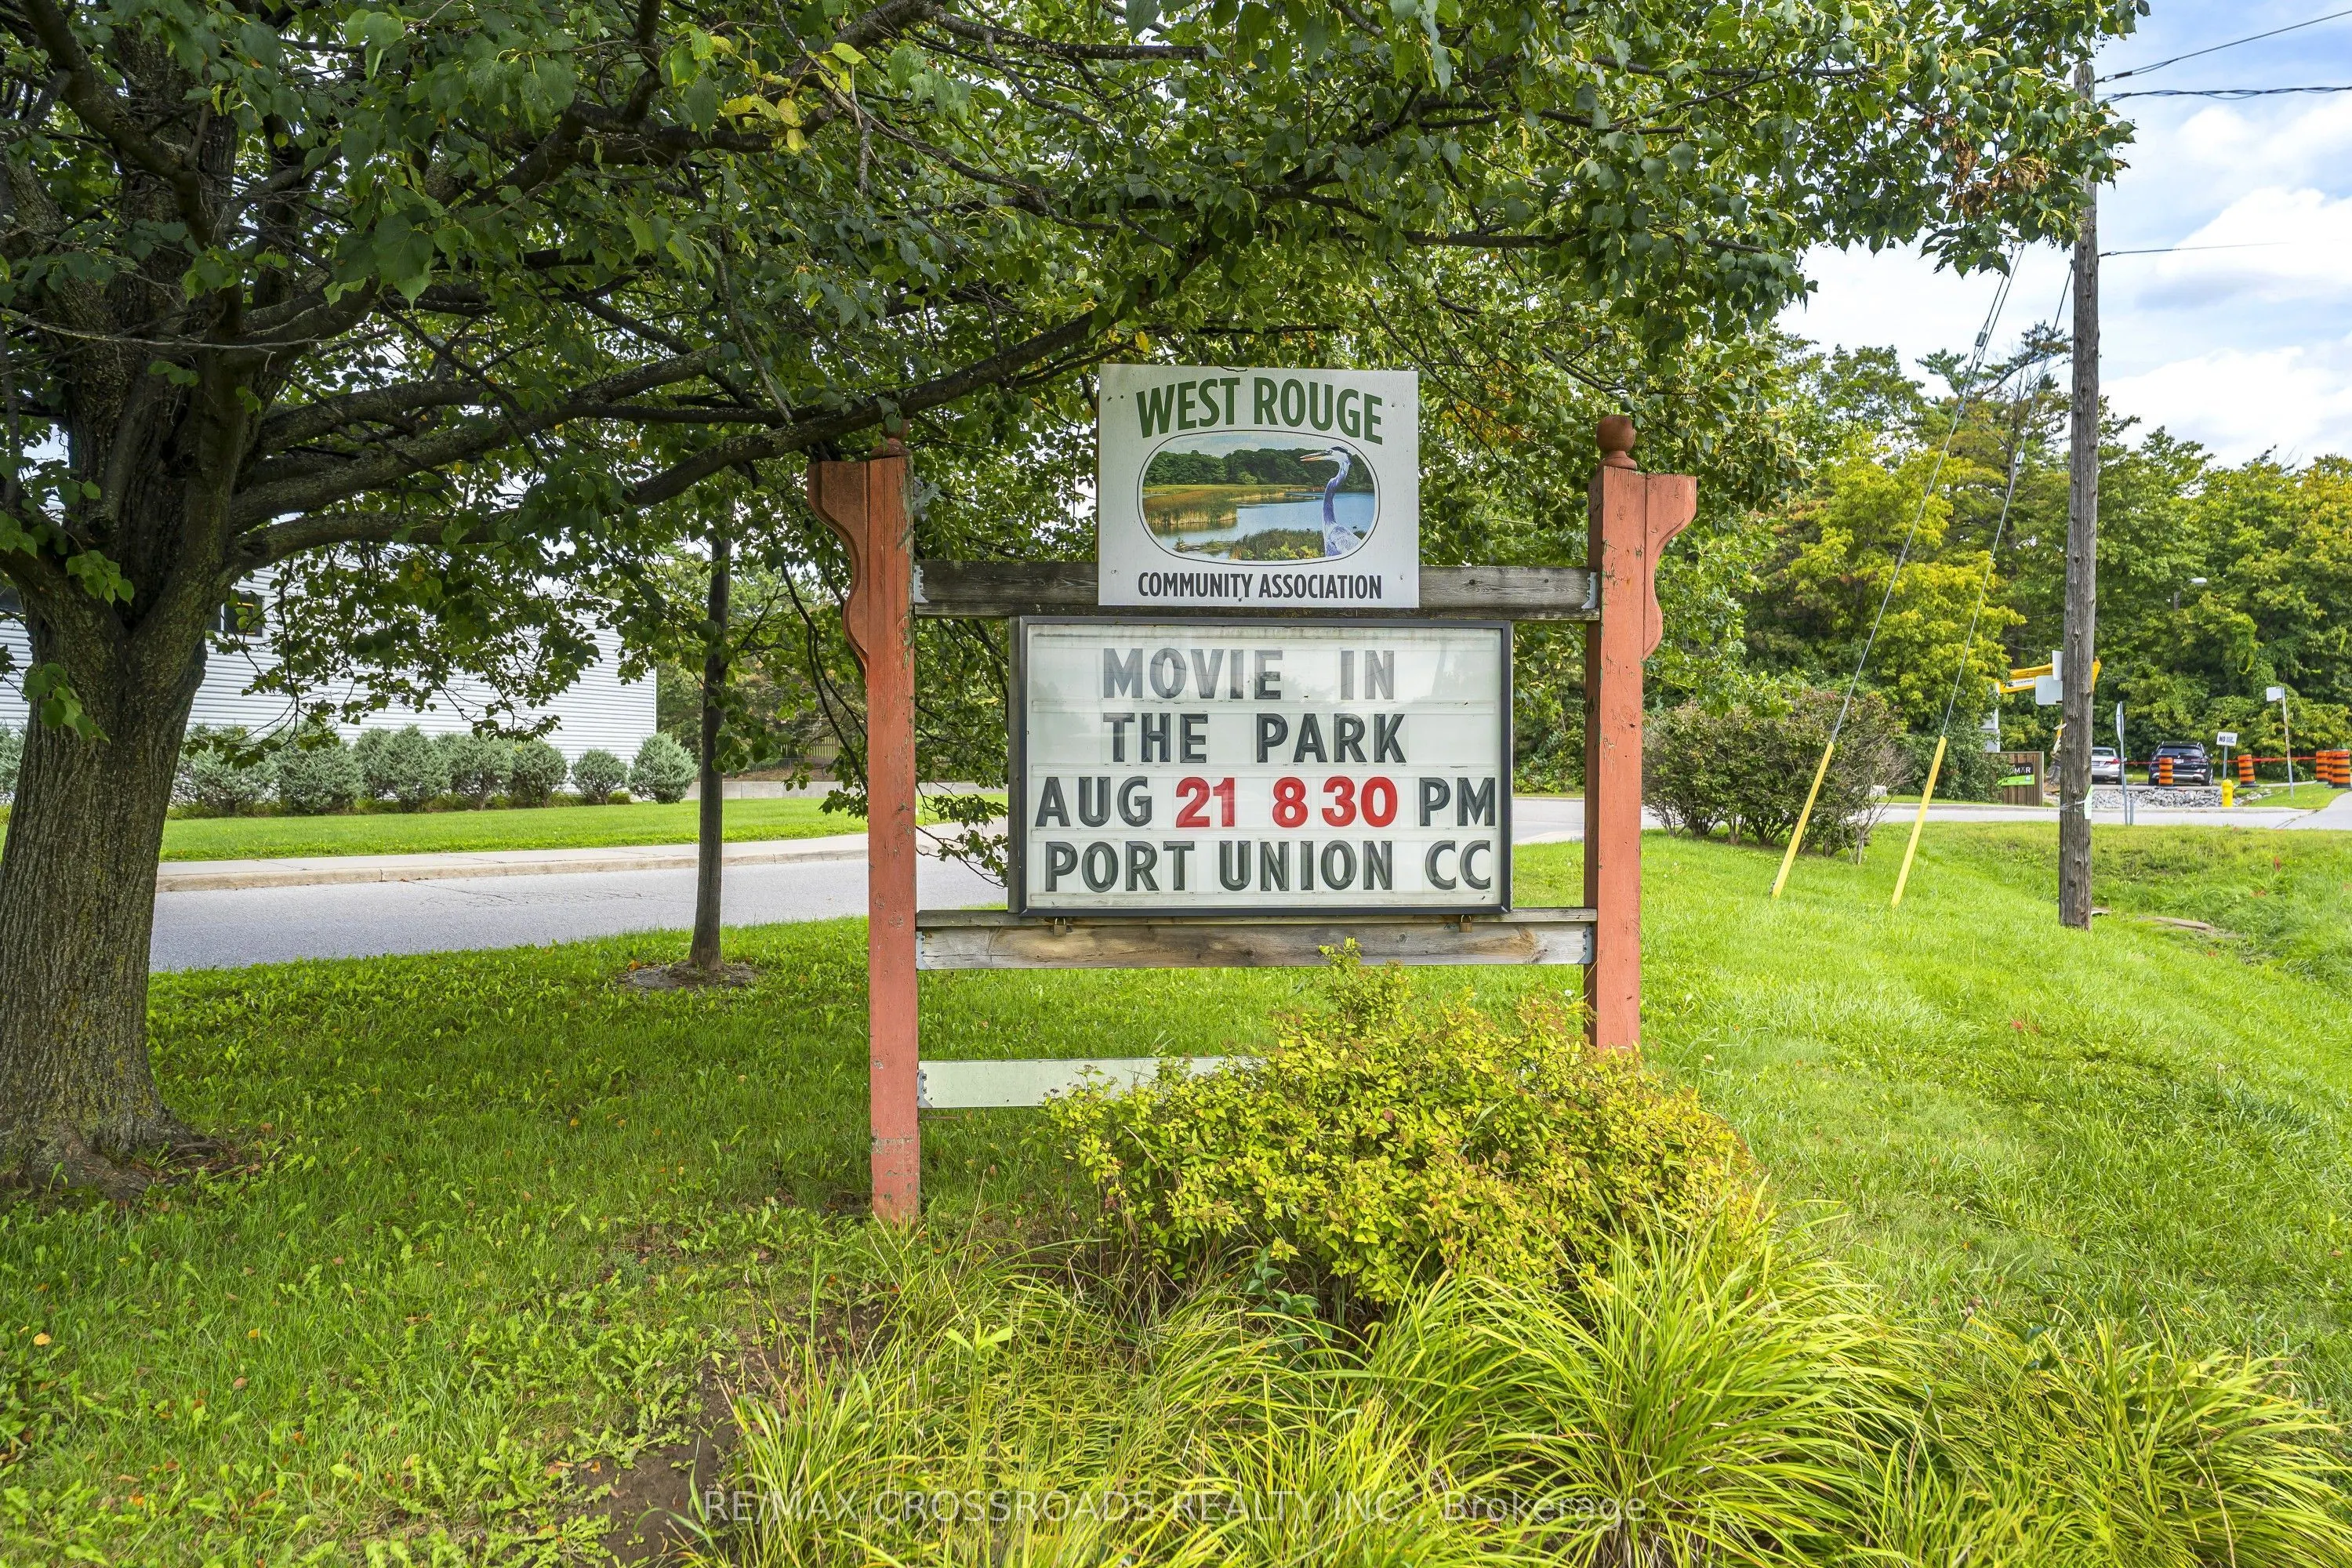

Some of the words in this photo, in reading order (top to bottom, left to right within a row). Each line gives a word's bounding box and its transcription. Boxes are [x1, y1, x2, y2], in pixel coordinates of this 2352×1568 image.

[1136, 377, 1240, 438] WEST
[1254, 376, 1383, 445] ROUGE
[1138, 572, 1253, 598] COMMUNITY
[1258, 574, 1382, 599] ASSOCIATION
[1103, 648, 1283, 700] MOVIE
[1341, 650, 1395, 700] IN
[1103, 712, 1208, 763] THE
[1256, 713, 1406, 764] PARK
[1036, 775, 1152, 827] AUG
[1176, 776, 1236, 827] 21
[1272, 775, 1398, 827] 830
[1420, 777, 1496, 827] PM
[1045, 840, 1195, 892] PORT
[1219, 840, 1393, 892] UNION
[1425, 839, 1491, 891] CC
